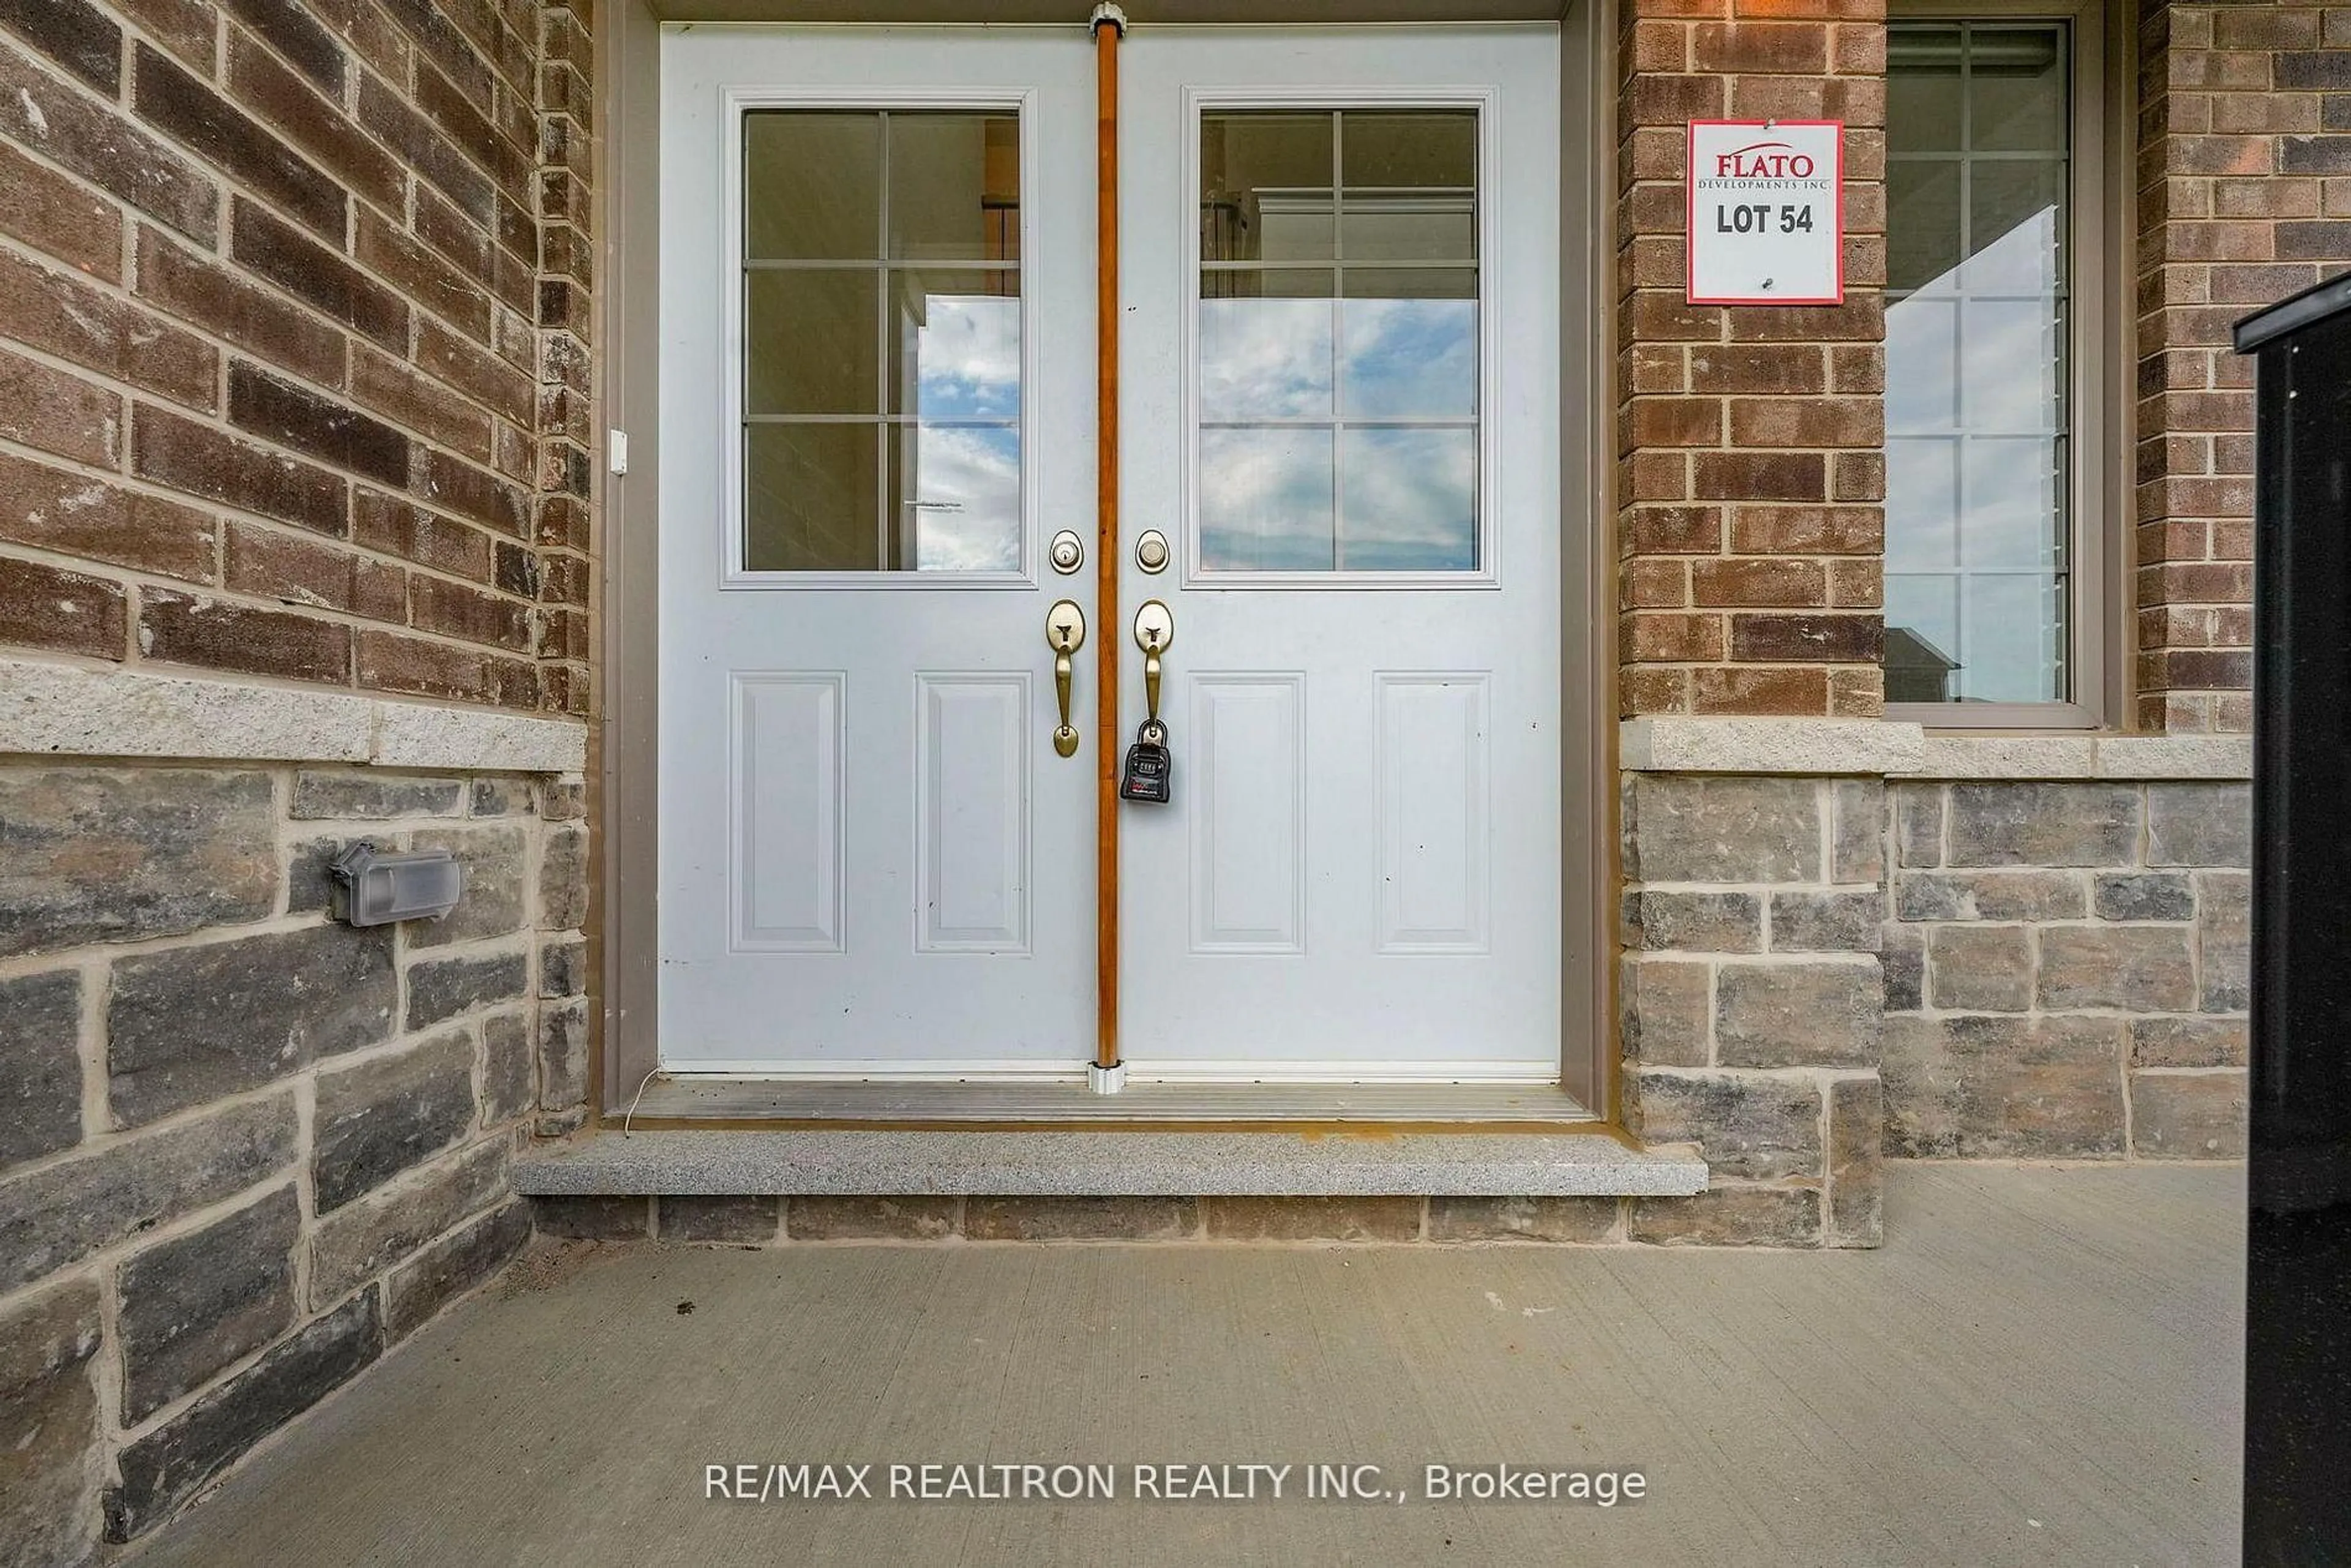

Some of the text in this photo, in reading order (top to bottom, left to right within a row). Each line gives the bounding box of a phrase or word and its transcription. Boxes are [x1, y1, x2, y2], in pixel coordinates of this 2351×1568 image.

[1716, 154, 1814, 178] FLATO
[1698, 179, 1797, 189] DEVELOPMENTS
[1717, 204, 1813, 233] LOT 54
